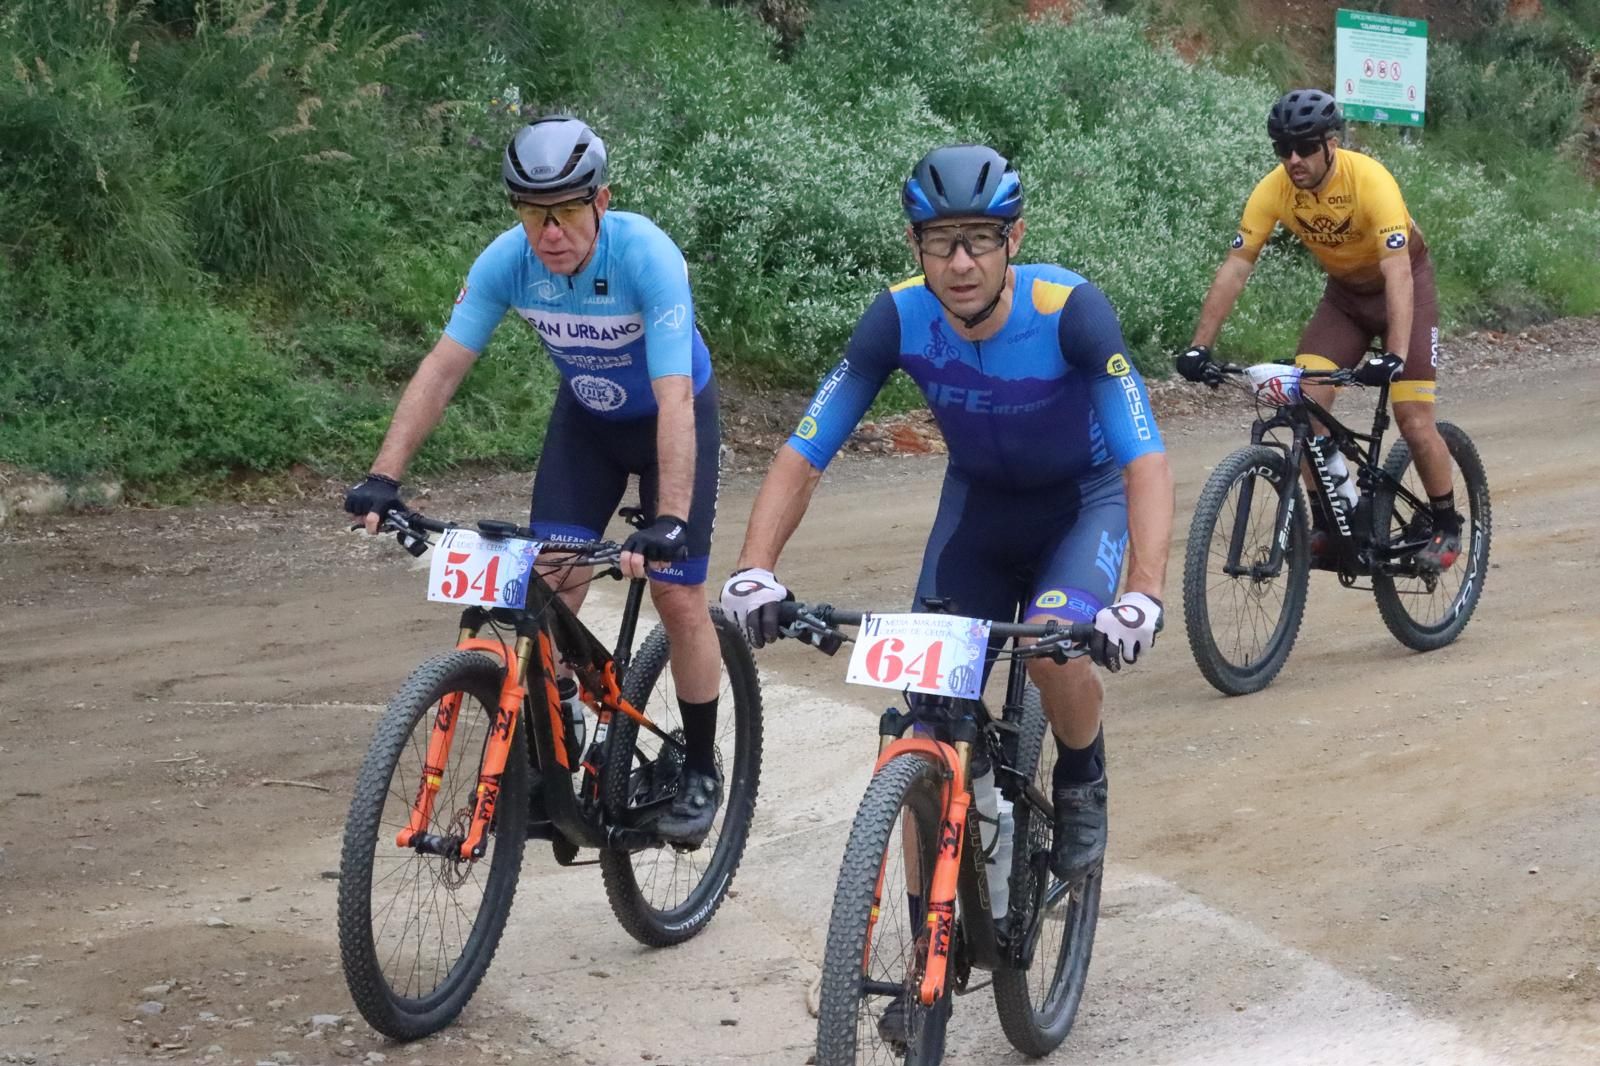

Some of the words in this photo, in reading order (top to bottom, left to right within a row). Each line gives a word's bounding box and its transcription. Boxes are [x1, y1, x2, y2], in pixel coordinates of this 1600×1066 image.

[527, 317, 561, 338] SAN
[567, 323, 641, 341] URBANO
[441, 552, 500, 603] 54
[865, 638, 944, 690] 64
